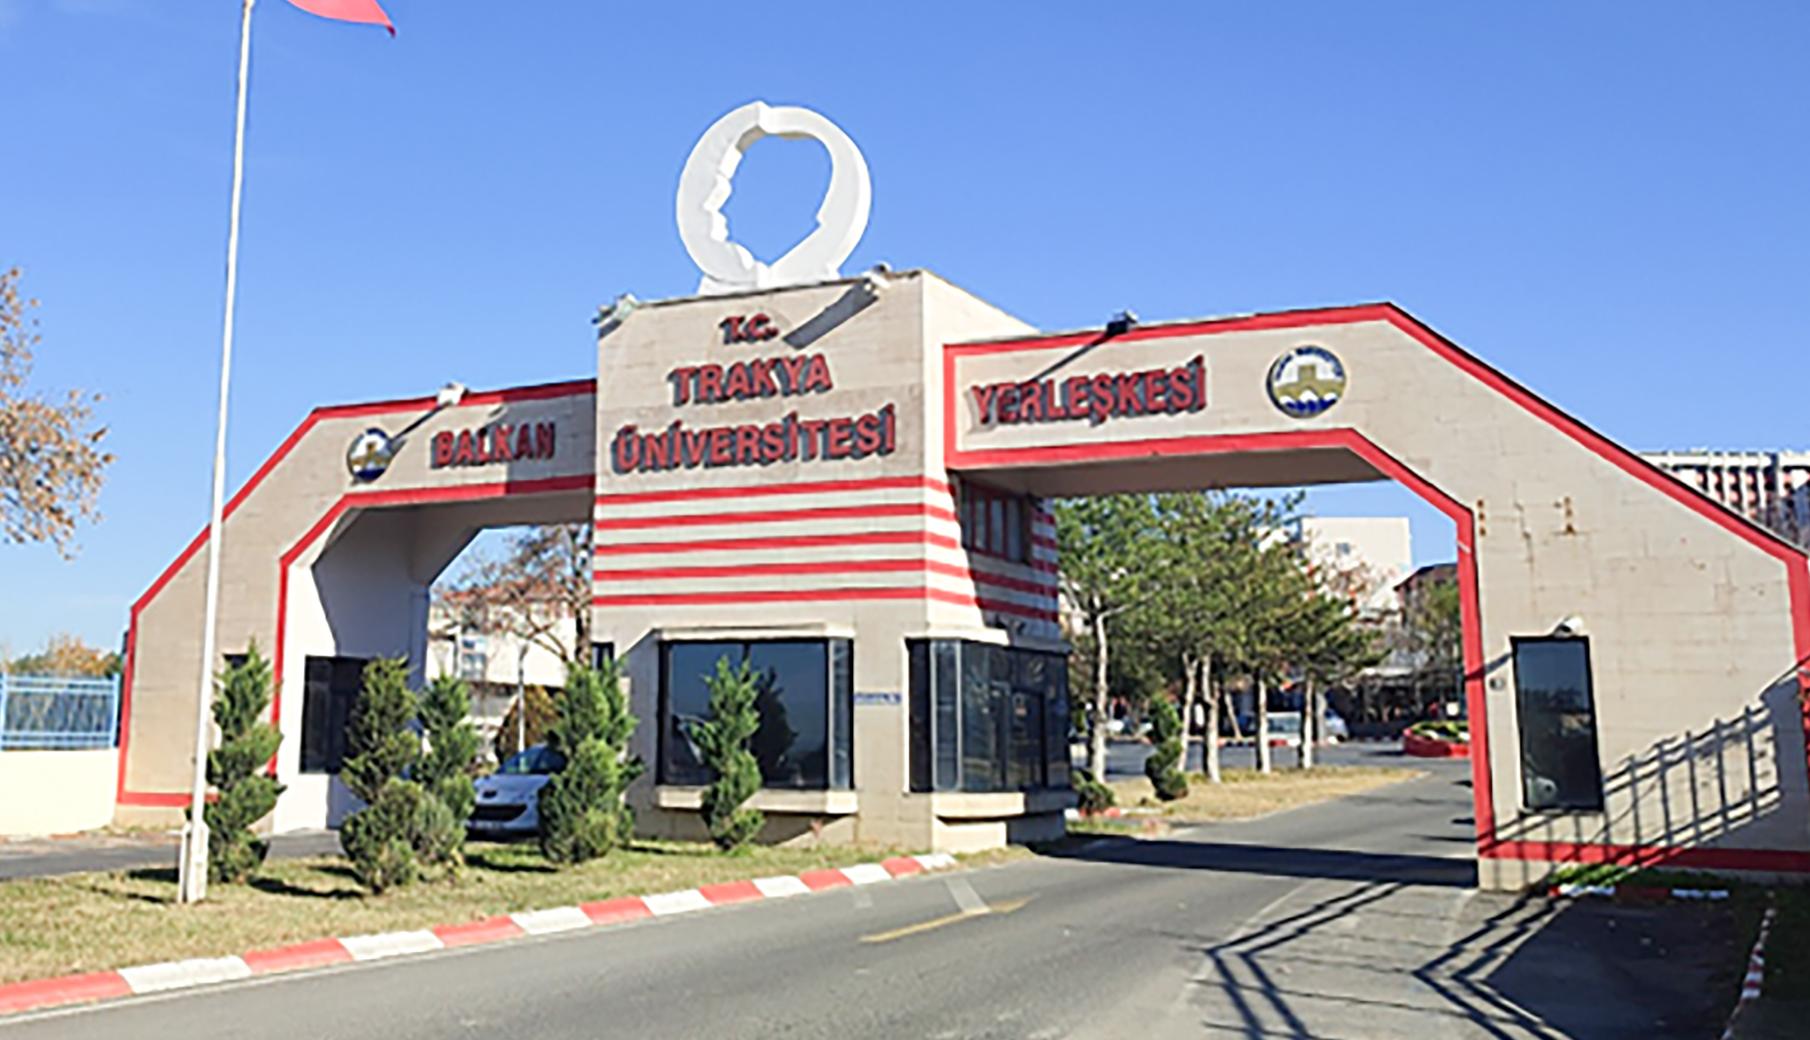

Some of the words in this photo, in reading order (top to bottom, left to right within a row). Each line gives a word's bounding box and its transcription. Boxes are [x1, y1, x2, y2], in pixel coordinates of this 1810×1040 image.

[719, 313, 779, 344] T.C.
[668, 353, 833, 406] TRAKYA
[970, 354, 1207, 426] YERLEŞKESİ
[431, 423, 555, 469] BALKAN
[611, 403, 896, 475] ÜNİVERSİTESİ
